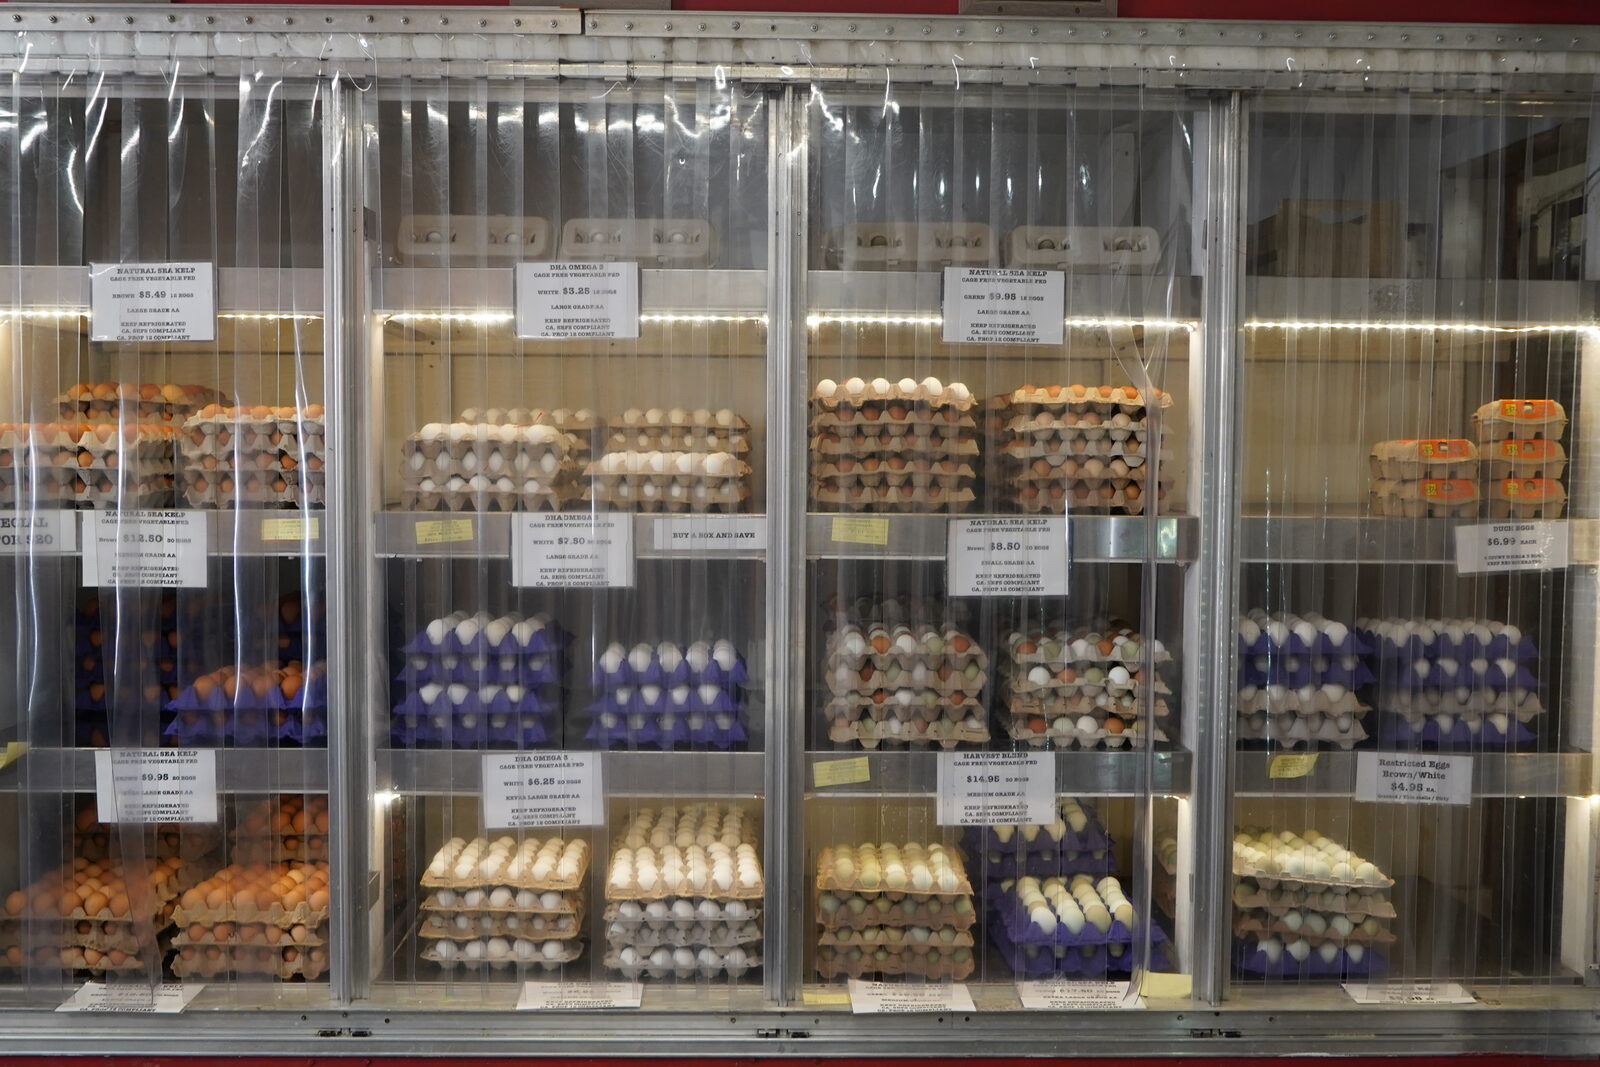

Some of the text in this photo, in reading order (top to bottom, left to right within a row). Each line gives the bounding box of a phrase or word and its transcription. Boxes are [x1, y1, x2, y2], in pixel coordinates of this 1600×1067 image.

[0, 518, 48, 528] ECIAL
[0, 535, 21, 545] OR
[1429, 761, 1450, 769] Eggs
[1383, 771, 1445, 779] Brown/White
[1391, 783, 1423, 791] $4.95
